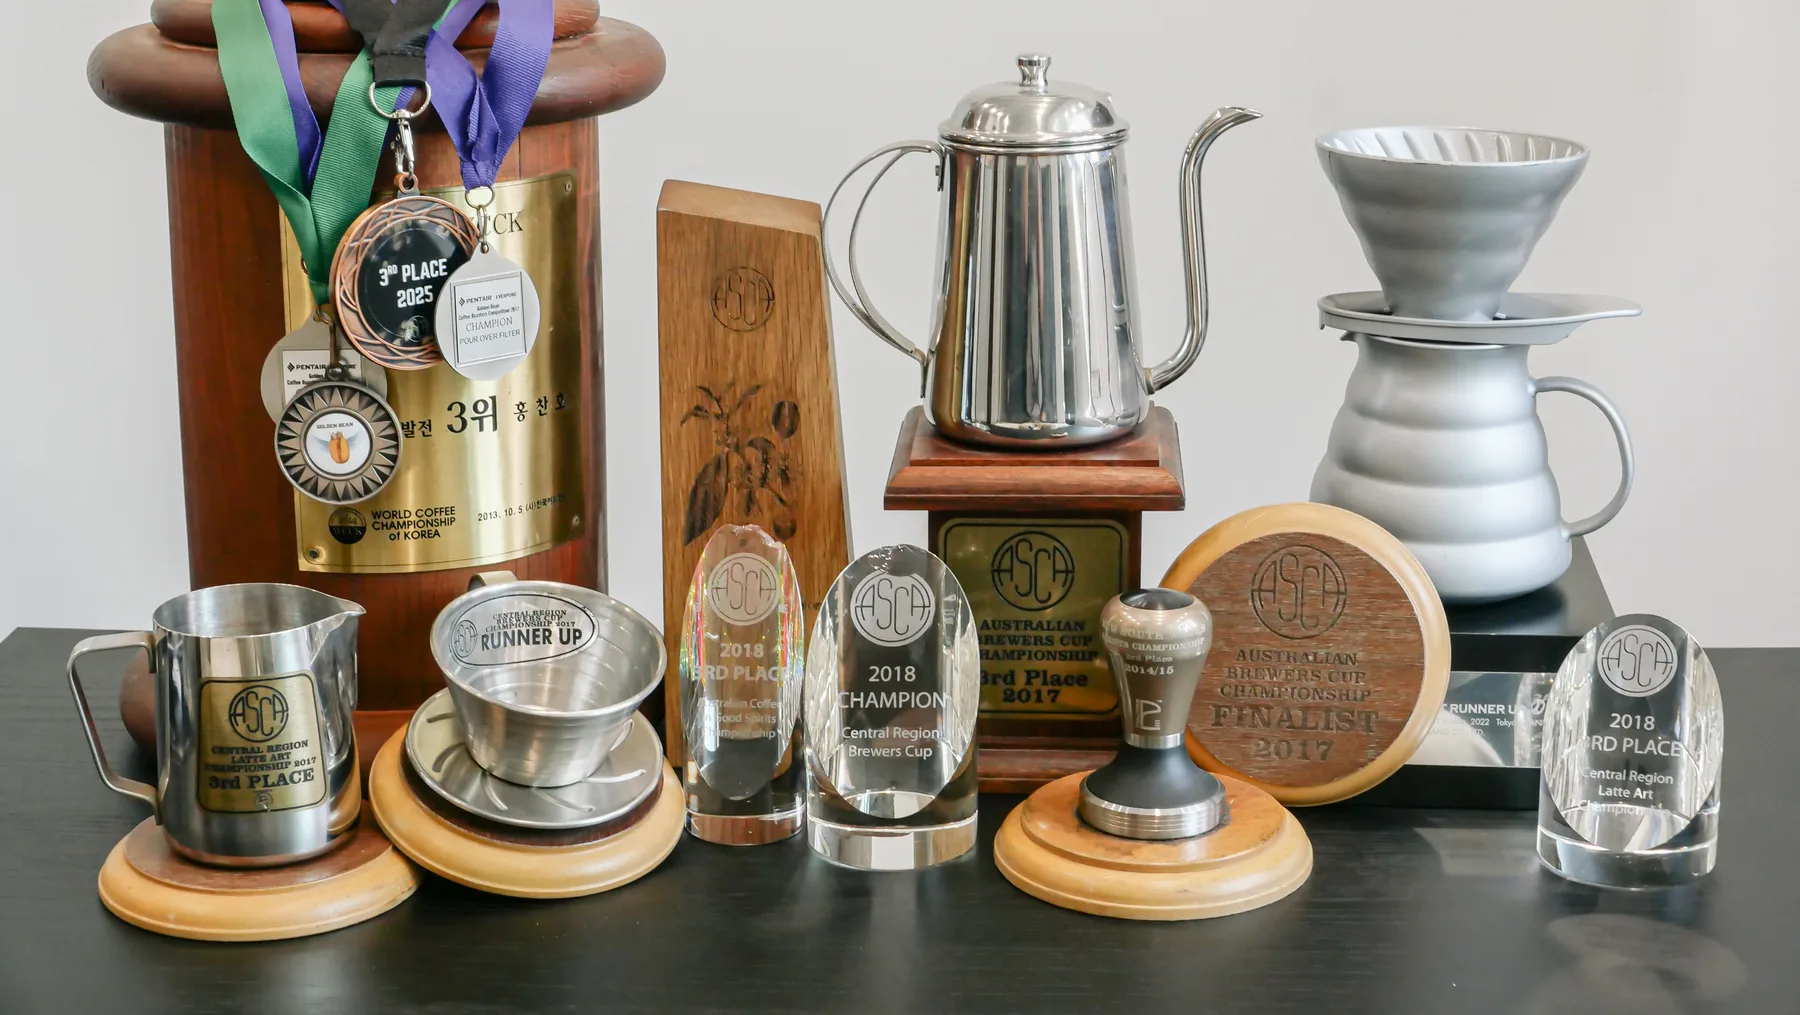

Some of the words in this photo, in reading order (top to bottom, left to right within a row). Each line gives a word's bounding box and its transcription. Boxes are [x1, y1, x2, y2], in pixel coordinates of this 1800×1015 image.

[470, 210, 524, 236] CK
[378, 264, 399, 287] 3RD
[401, 258, 449, 283] PLACE
[396, 285, 434, 308] 2025
[466, 295, 493, 304] PENTAIR
[488, 308, 510, 316] Competition
[465, 316, 513, 332] CHAMPION
[459, 336, 479, 345] POUR
[479, 332, 498, 342] OVER
[499, 329, 521, 339] FILTER
[446, 394, 498, 435] 3위
[371, 509, 412, 520] WORLD
[415, 506, 456, 517] COFFEE
[371, 517, 456, 531] CHAMPIONSHIP
[389, 531, 401, 541] of
[404, 530, 441, 541] KOREA
[992, 538, 1074, 604] ASCA
[711, 563, 776, 616] ASCA
[1252, 553, 1347, 629] ASCA
[492, 610, 530, 620] CENTRAL
[533, 609, 567, 617] REGION
[855, 578, 931, 635] ASCA
[543, 614, 563, 622] CUP
[980, 620, 1085, 632] AUSTRALIAN
[485, 621, 552, 633] CHAMPIONSHIP
[1120, 626, 1163, 640] SOUTH
[481, 628, 553, 652] RUNNER
[559, 628, 583, 646] UP
[1060, 636, 1093, 647] CUP
[1131, 637, 1205, 652] CHAMPIONSHIP
[719, 643, 764, 658] 2018
[978, 651, 1099, 662] HAMPIONSHIP
[1125, 653, 1142, 661] 3rd
[1144, 654, 1173, 663] Place
[1236, 649, 1358, 666] AUSTRALIAN
[1602, 633, 1674, 688] ASCA
[869, 666, 916, 682] 2018
[1124, 663, 1175, 675] 2014/15
[1227, 667, 1321, 683] BREWERS
[1327, 671, 1366, 684] CUP
[980, 669, 1016, 686] 3rd
[1024, 670, 1088, 686] Place
[838, 691, 947, 709] CHAMPION
[1003, 688, 1060, 703] 2017
[1219, 684, 1372, 702] CHAMPIONSHIP
[230, 690, 289, 737] ASCA
[1450, 703, 1505, 714] RUNNER
[744, 712, 777, 724] Spirits
[1211, 703, 1379, 733] FINALIST
[1470, 718, 1490, 726] 2022
[1496, 718, 1515, 728] Tokyo
[1609, 713, 1655, 730] 2018
[842, 727, 889, 739] Central
[893, 727, 940, 743] Region
[211, 746, 263, 755] CENTRAL
[266, 740, 309, 753] REGION
[849, 745, 901, 758] Brewers
[905, 745, 933, 760] Cup
[1253, 738, 1335, 762] 2017
[1622, 737, 1681, 757] PLACE
[205, 761, 291, 773] CHAMPIONSHIP
[294, 757, 317, 768] 2017
[231, 755, 266, 764] LATTE
[269, 752, 292, 762] ART
[209, 775, 241, 790] 3rd
[247, 768, 315, 789] PLACE
[1581, 767, 1626, 780] Central
[1629, 770, 1674, 785] Region
[1598, 784, 1631, 798] Latte
[1633, 787, 1654, 800] Art
